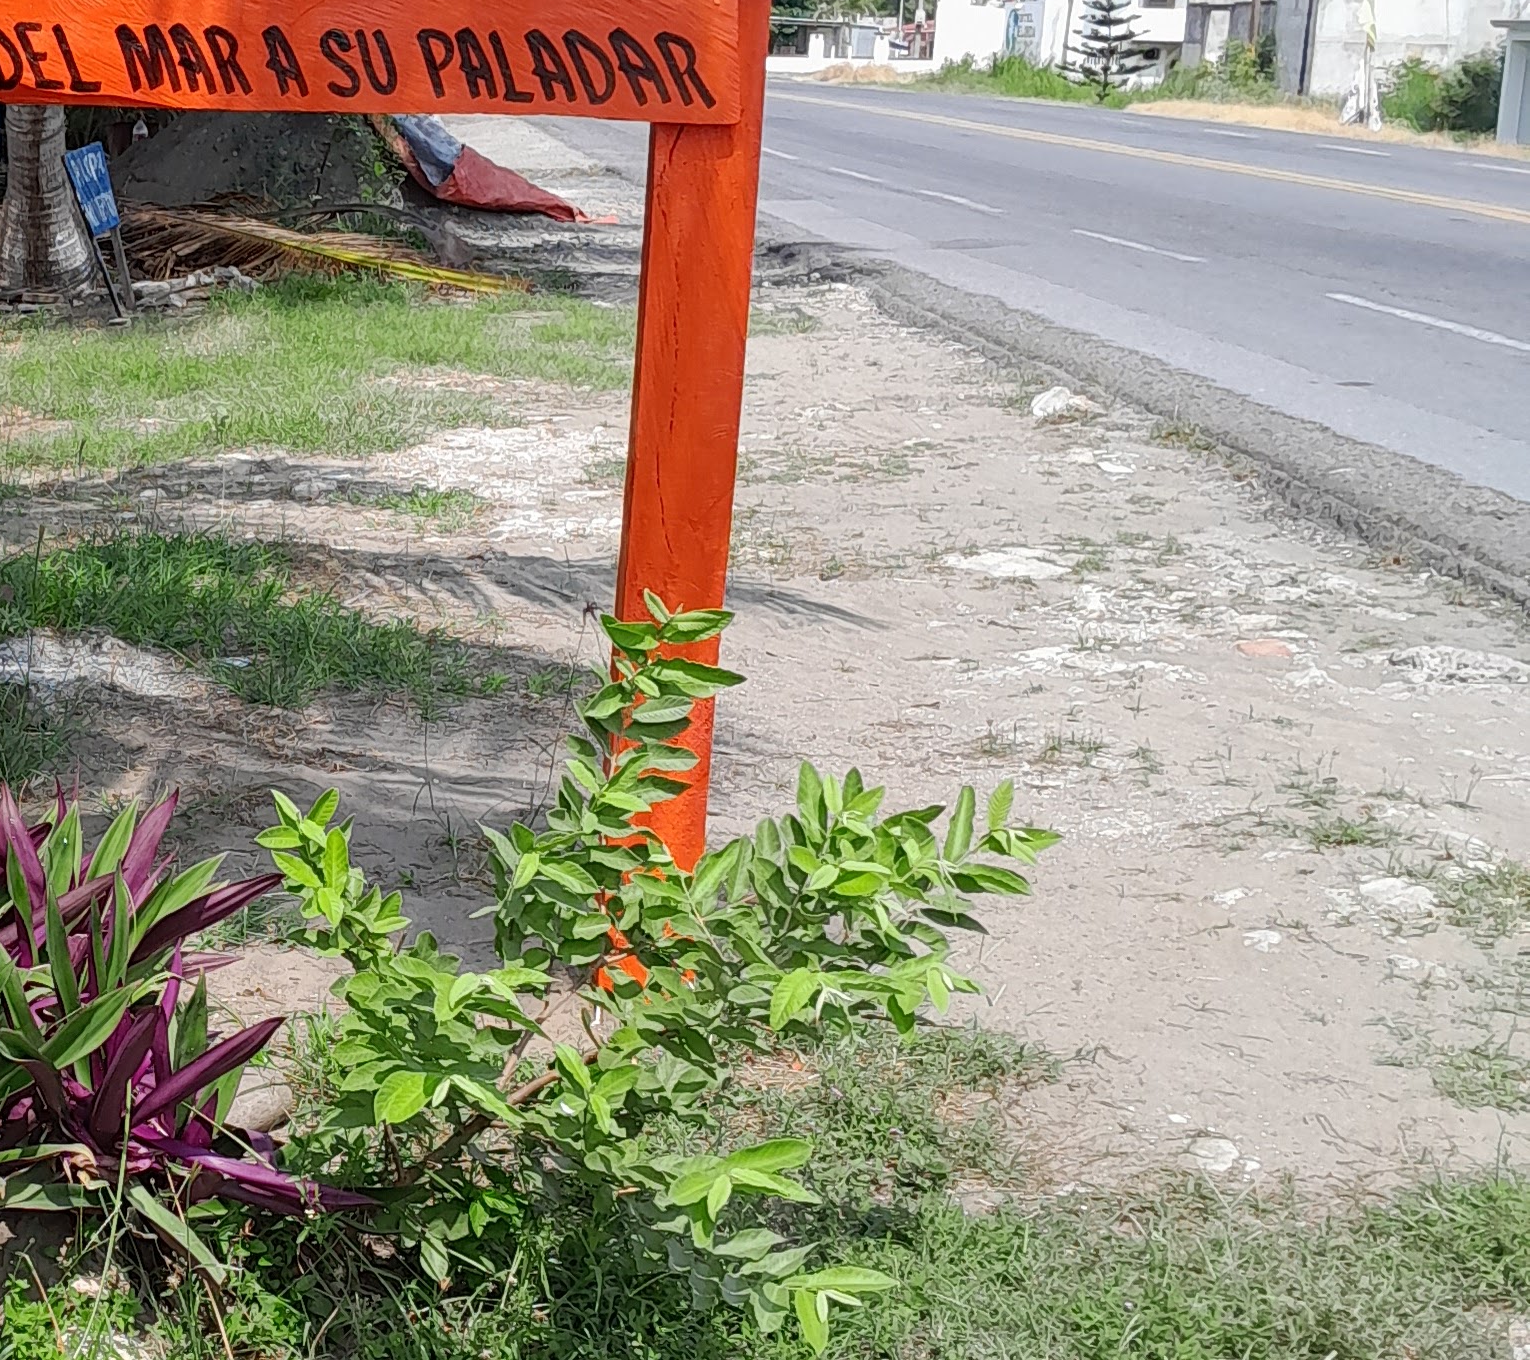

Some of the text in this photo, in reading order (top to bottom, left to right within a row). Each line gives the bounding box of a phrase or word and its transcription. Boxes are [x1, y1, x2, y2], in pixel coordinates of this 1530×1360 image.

[116, 24, 252, 93] MAR
[263, 26, 307, 95] A
[320, 29, 396, 97] SU
[416, 27, 714, 108] PALADAR
